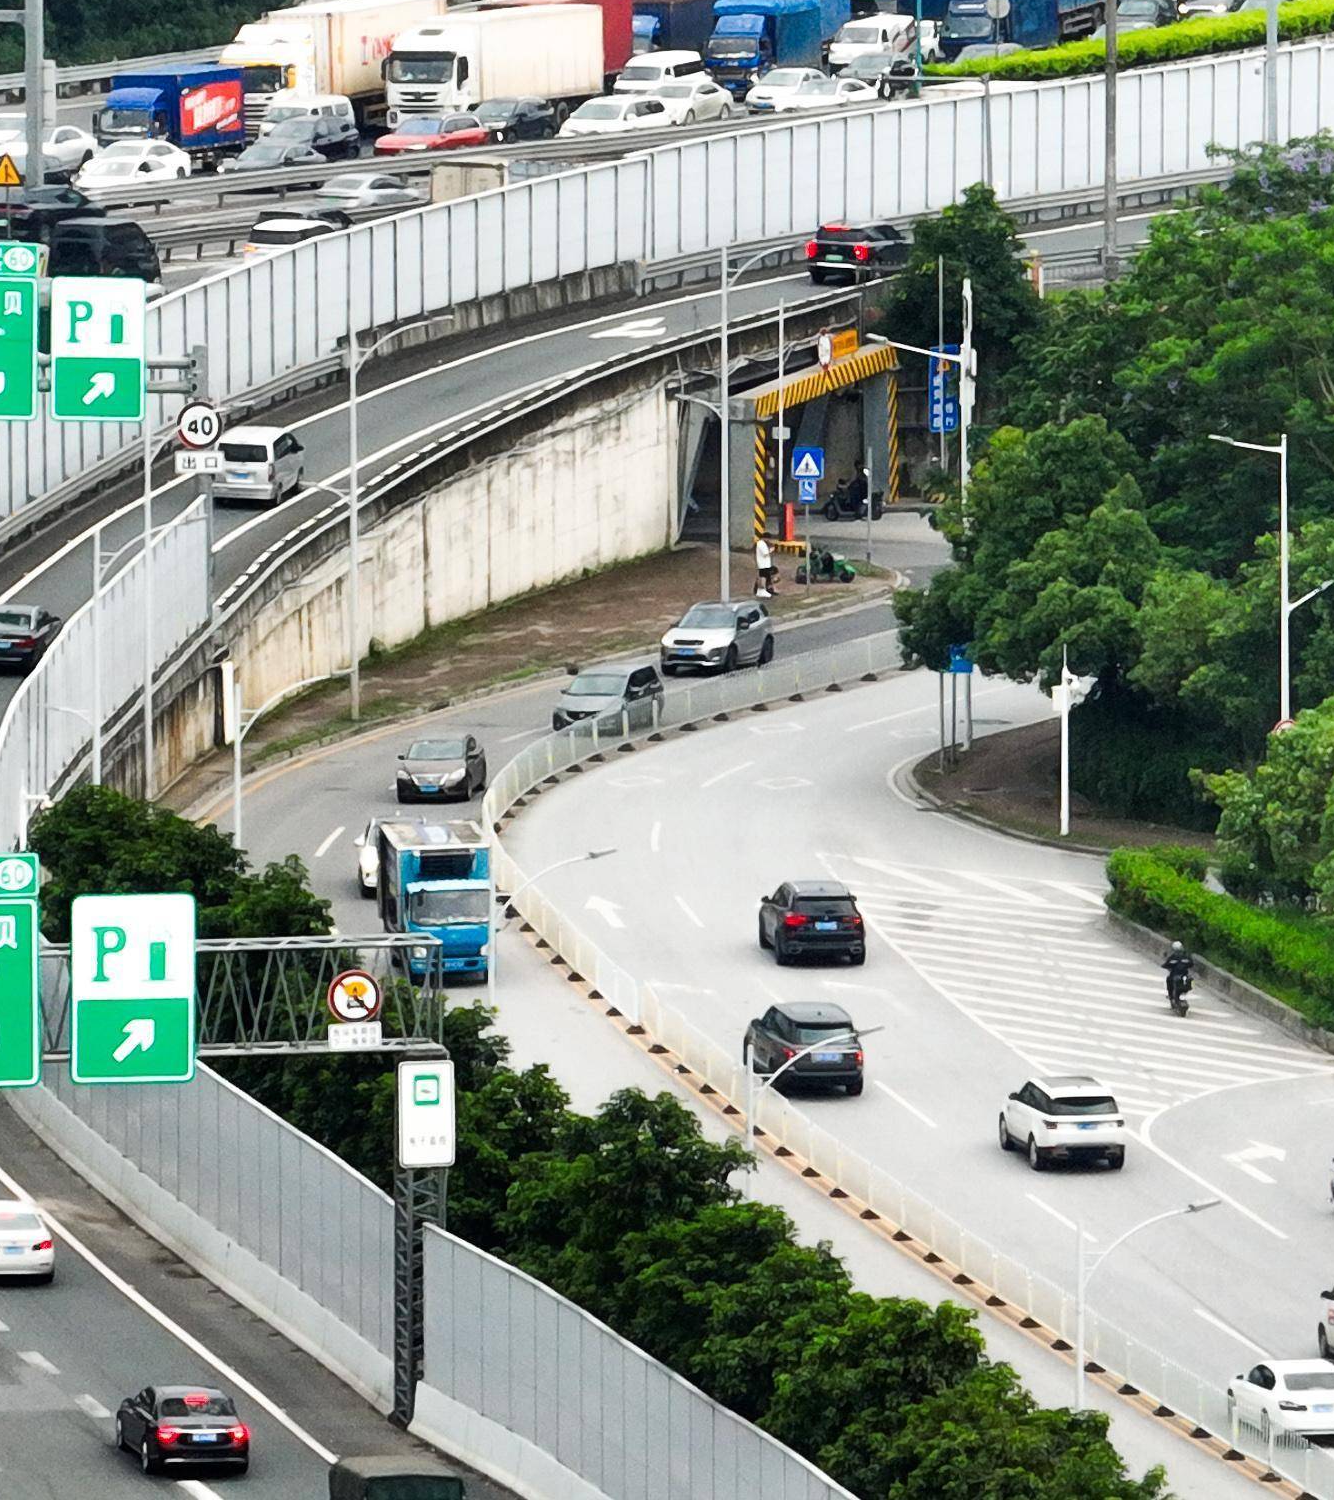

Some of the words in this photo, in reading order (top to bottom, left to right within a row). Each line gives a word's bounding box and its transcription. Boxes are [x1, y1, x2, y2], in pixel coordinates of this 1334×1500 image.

[10, 252, 29, 266] 60
[67, 300, 93, 343] P
[187, 415, 213, 436] 40
[182, 455, 217, 470] 出口
[0, 864, 25, 886] 60
[91, 925, 127, 982] P
